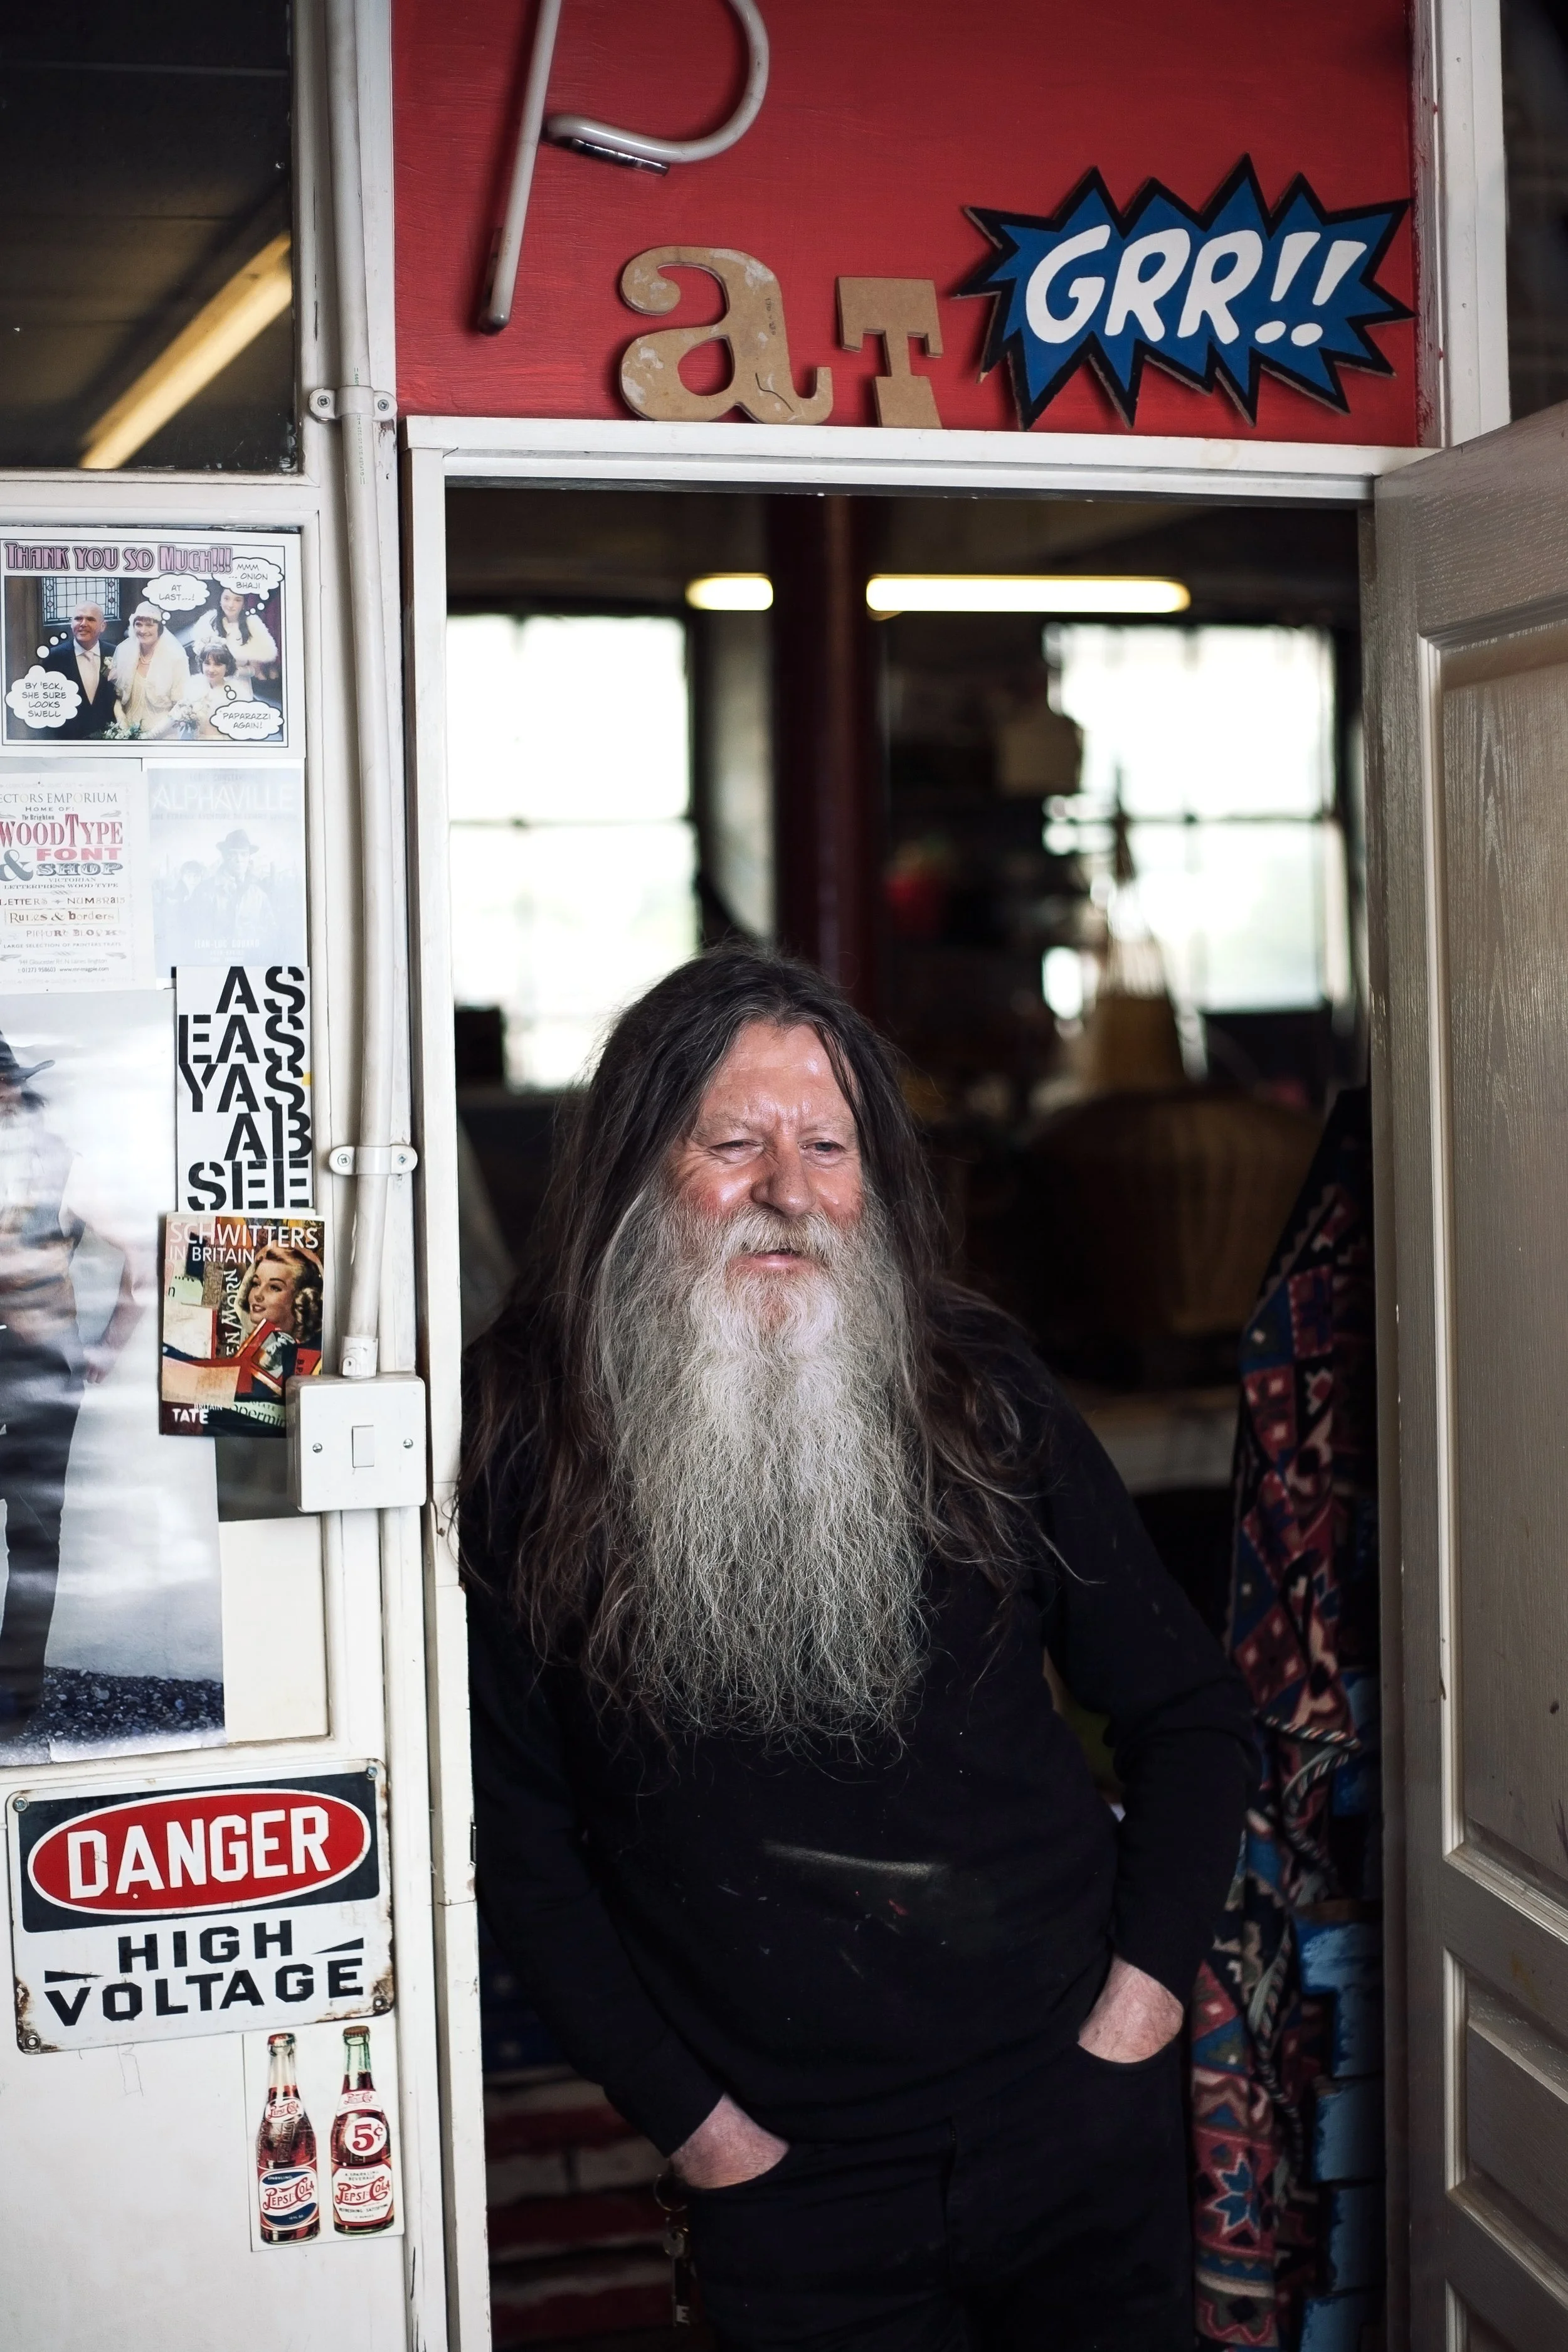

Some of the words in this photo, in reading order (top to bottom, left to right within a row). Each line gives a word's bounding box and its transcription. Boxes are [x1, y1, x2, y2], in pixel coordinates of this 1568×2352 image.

[1025, 225, 1367, 347] GRR!!
[72, 546, 119, 572] YOU
[122, 546, 156, 572] SO
[47, 792, 118, 804] EMPORIUM
[152, 784, 295, 811] ALPHAVILLE
[36, 848, 122, 861] FONT
[36, 863, 124, 876] SHOP
[51, 913, 65, 921] &
[68, 911, 115, 920] borders
[216, 966, 305, 1014] AS
[178, 1014, 305, 1063] EAS
[178, 1063, 305, 1113] YAS
[187, 1160, 309, 1211] SEE
[169, 1222, 319, 1248] SCHWITTERS
[169, 1247, 186, 1260] IN
[192, 1247, 255, 1264] BRITAIN
[171, 1408, 209, 1425] TATE
[67, 1805, 331, 1900] DANGER
[118, 1920, 293, 1974] HIGH
[44, 1957, 364, 2027] VOLTAGE
